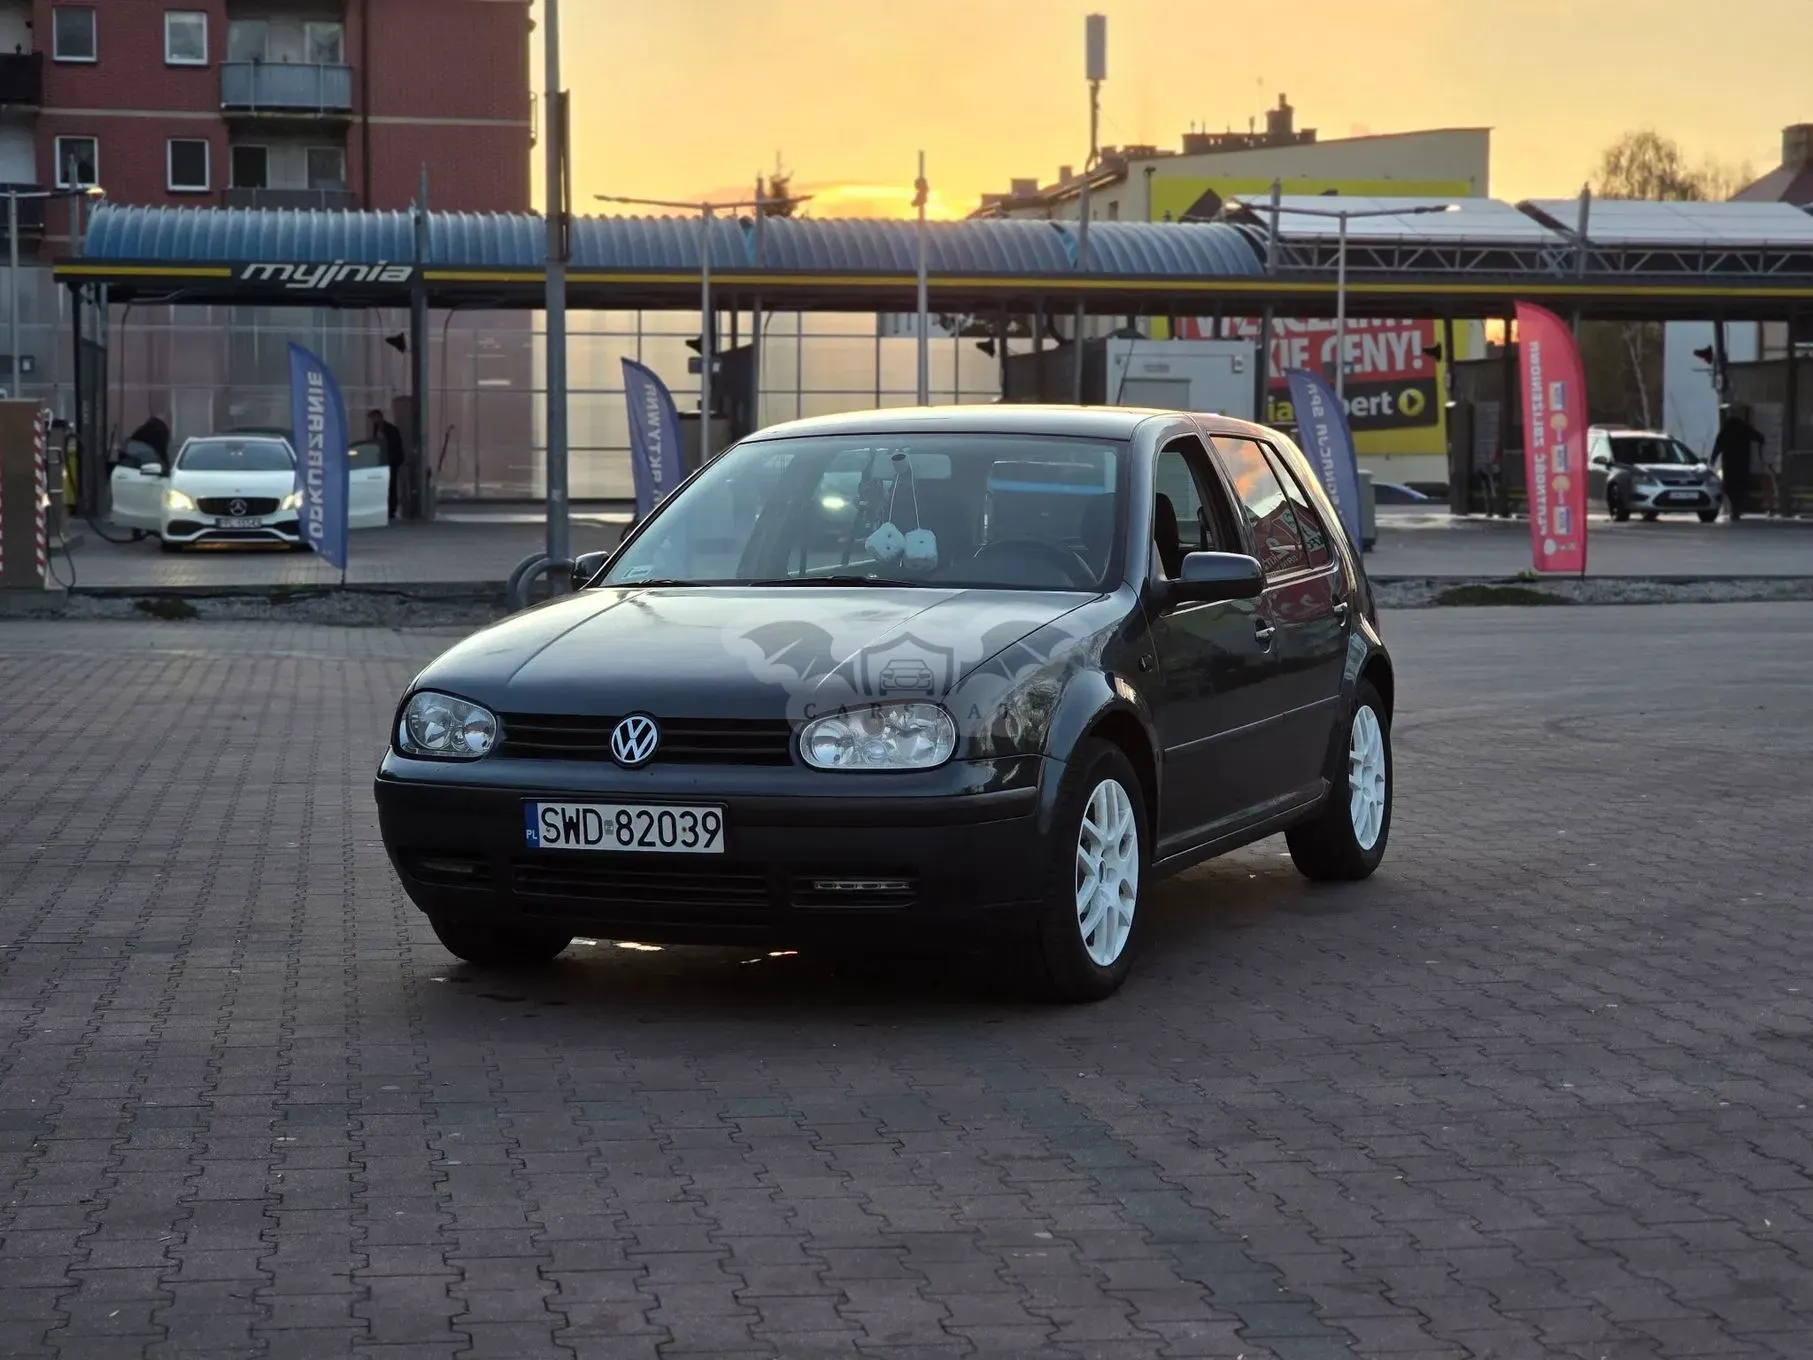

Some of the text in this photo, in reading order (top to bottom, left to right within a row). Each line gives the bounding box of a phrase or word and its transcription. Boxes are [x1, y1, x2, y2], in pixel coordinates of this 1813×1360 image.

[240, 259, 413, 288] myjnia
[526, 807, 721, 848] PL SWD 82039
